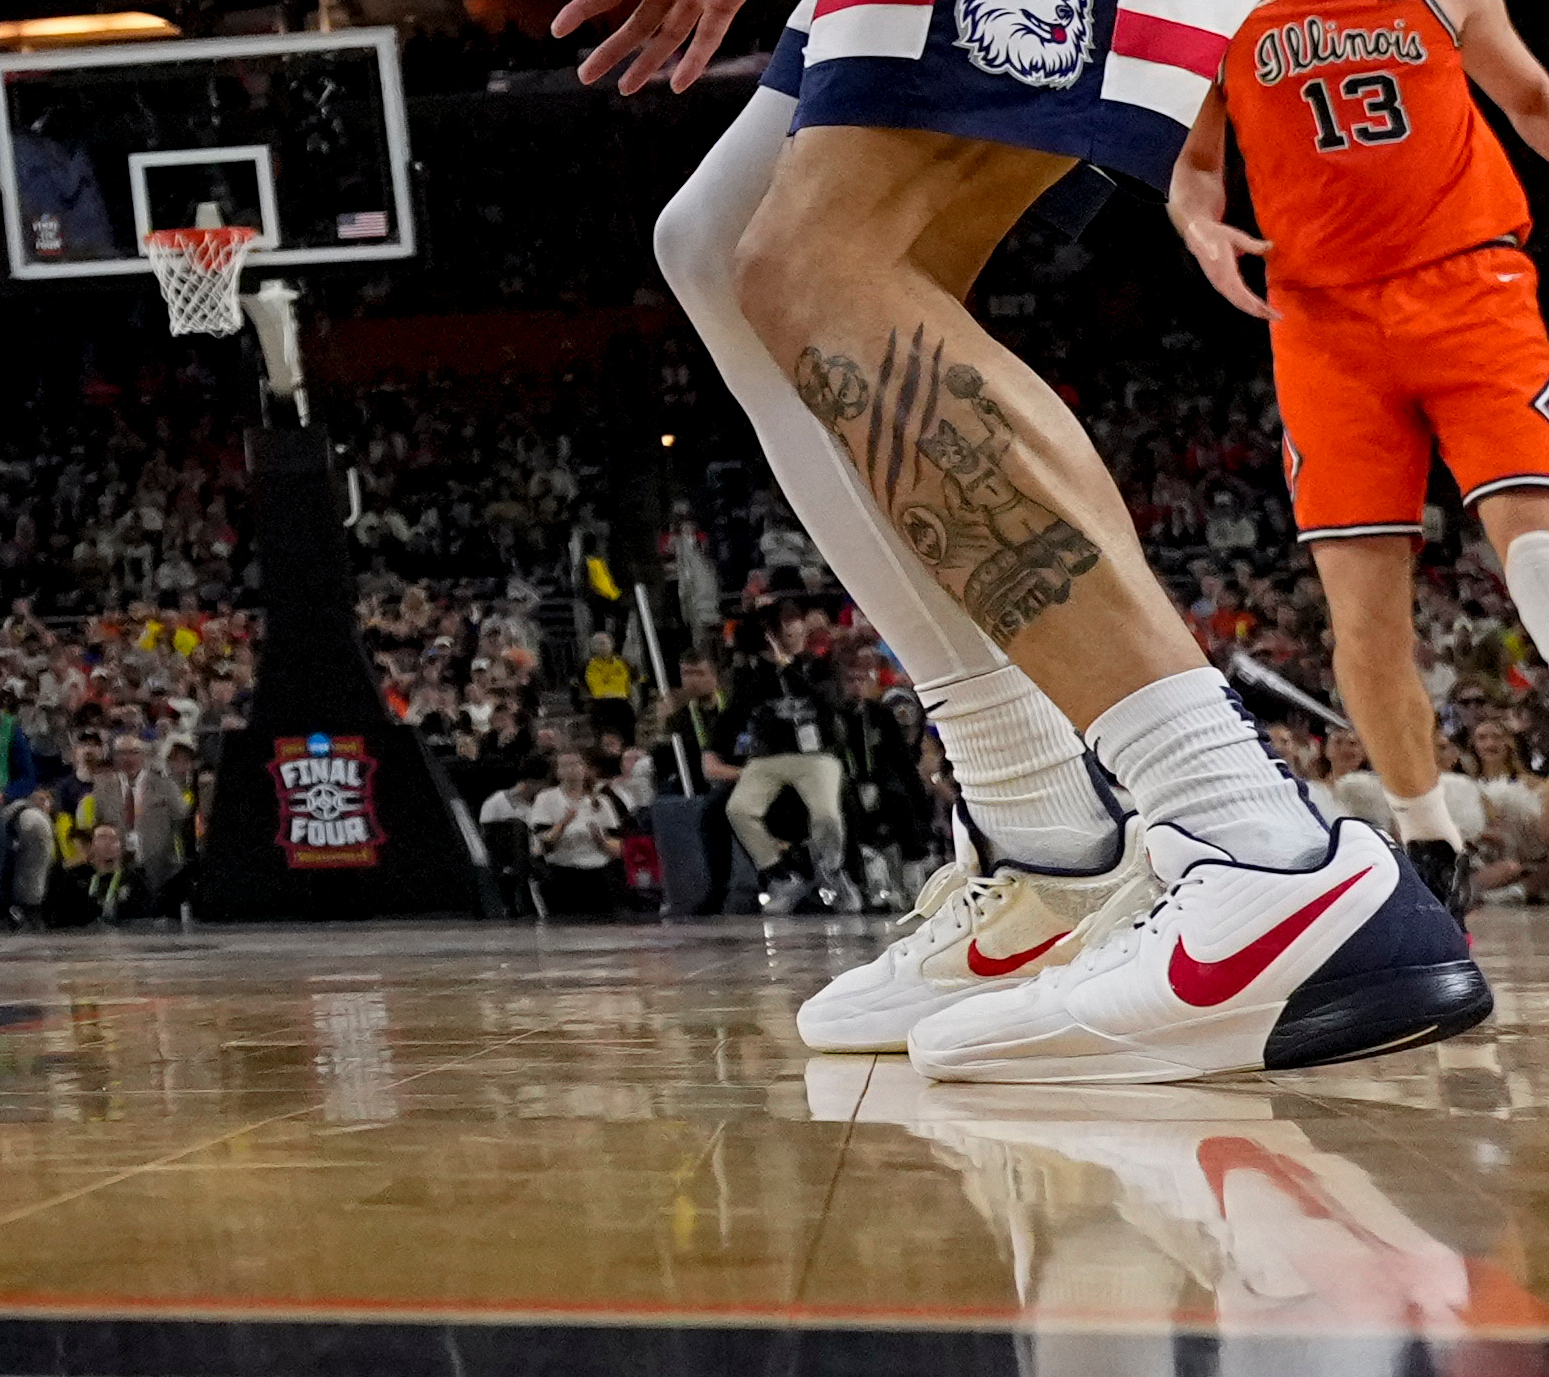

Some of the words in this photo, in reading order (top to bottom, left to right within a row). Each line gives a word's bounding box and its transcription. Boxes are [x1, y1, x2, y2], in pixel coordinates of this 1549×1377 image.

[1255, 15, 1428, 86] Illinois
[1300, 69, 1411, 153] 13
[280, 757, 362, 789] FINAL
[290, 816, 370, 846] FOUR
